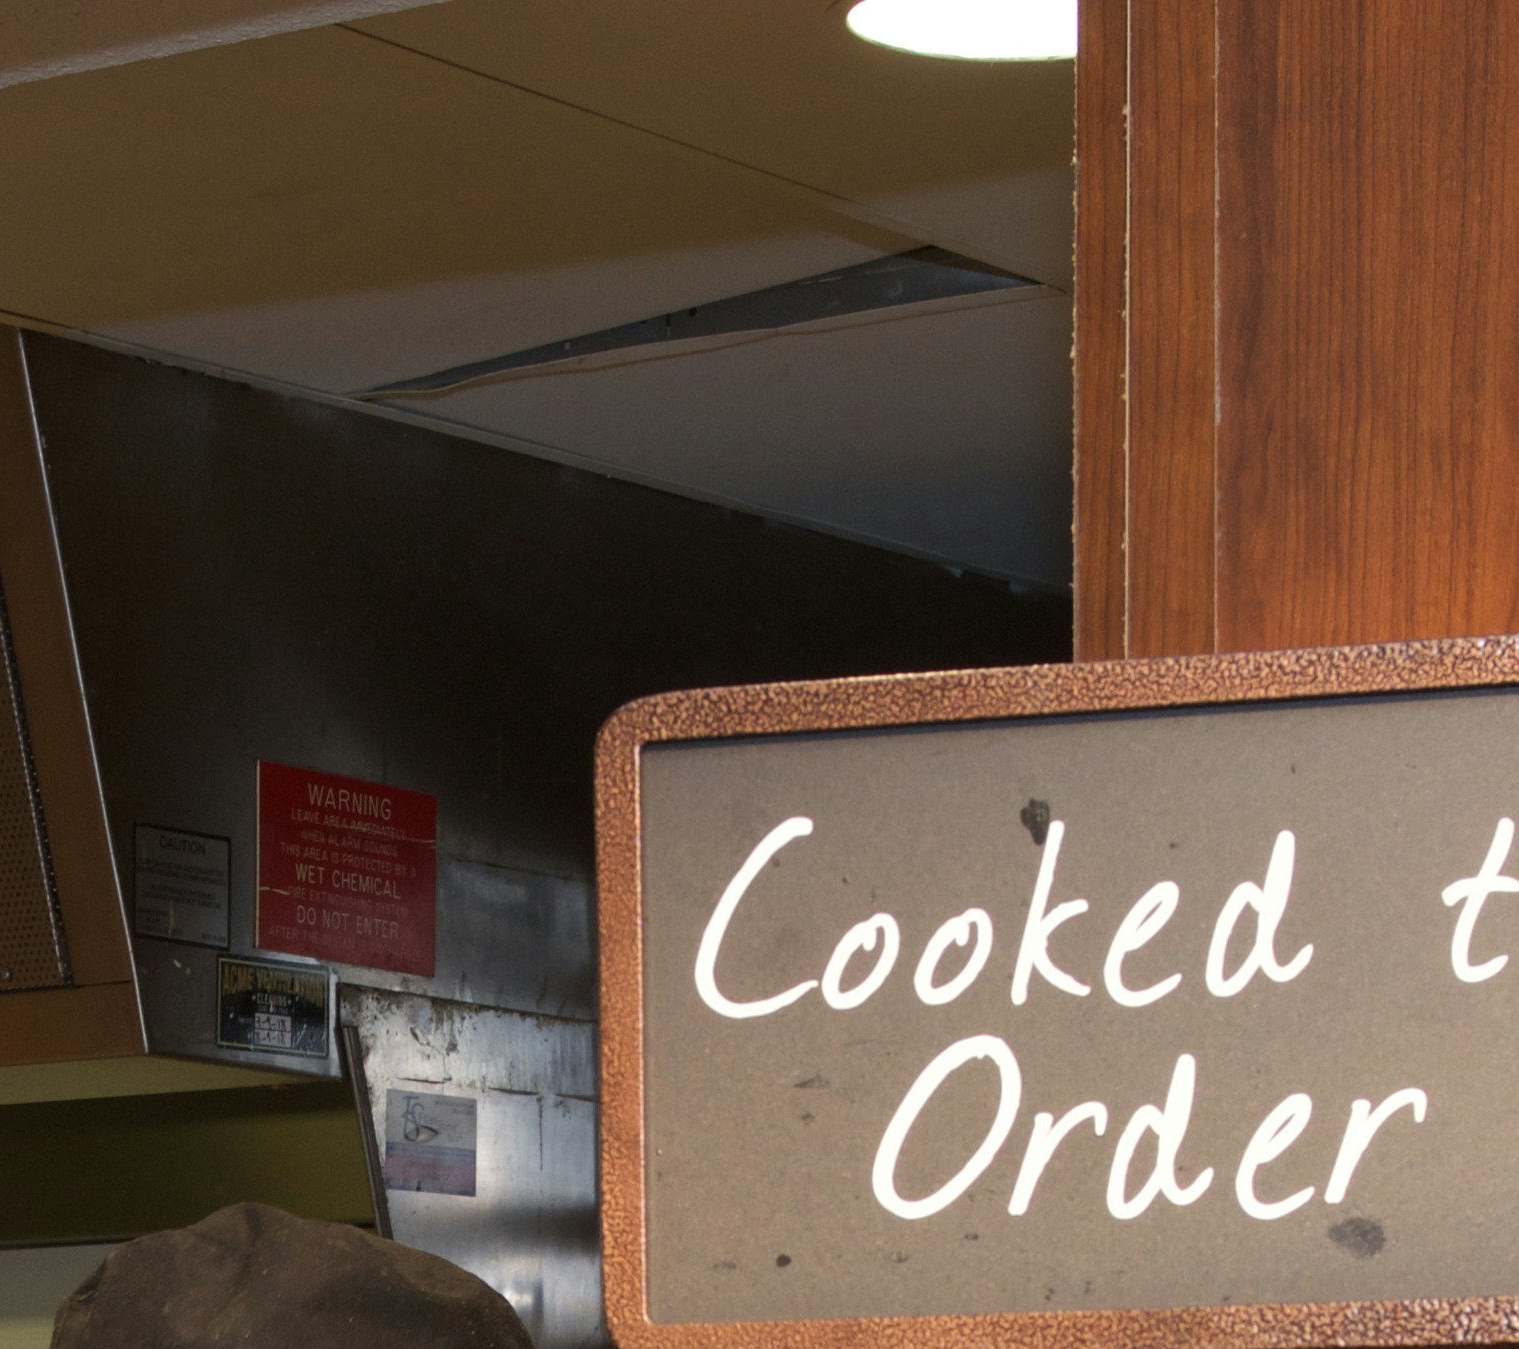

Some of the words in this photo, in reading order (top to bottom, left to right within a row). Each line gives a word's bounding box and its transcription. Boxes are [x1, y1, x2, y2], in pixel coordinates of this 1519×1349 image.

[291, 807, 320, 825] LEAVE
[322, 814, 348, 829] AREA
[307, 782, 393, 821] WARNING
[159, 835, 206, 856] CAUTION
[280, 841, 301, 857] THIS
[303, 845, 328, 861] AREA
[342, 853, 393, 874] PROTECTED
[327, 833, 361, 849] ALARM
[294, 863, 326, 885] WET
[331, 869, 402, 900] CHEMICAL
[296, 904, 317, 926] DO
[321, 909, 350, 931] NOT
[355, 916, 400, 939] ENTER
[693, 815, 1315, 1020] Cooked
[871, 1033, 1429, 1222] Order
